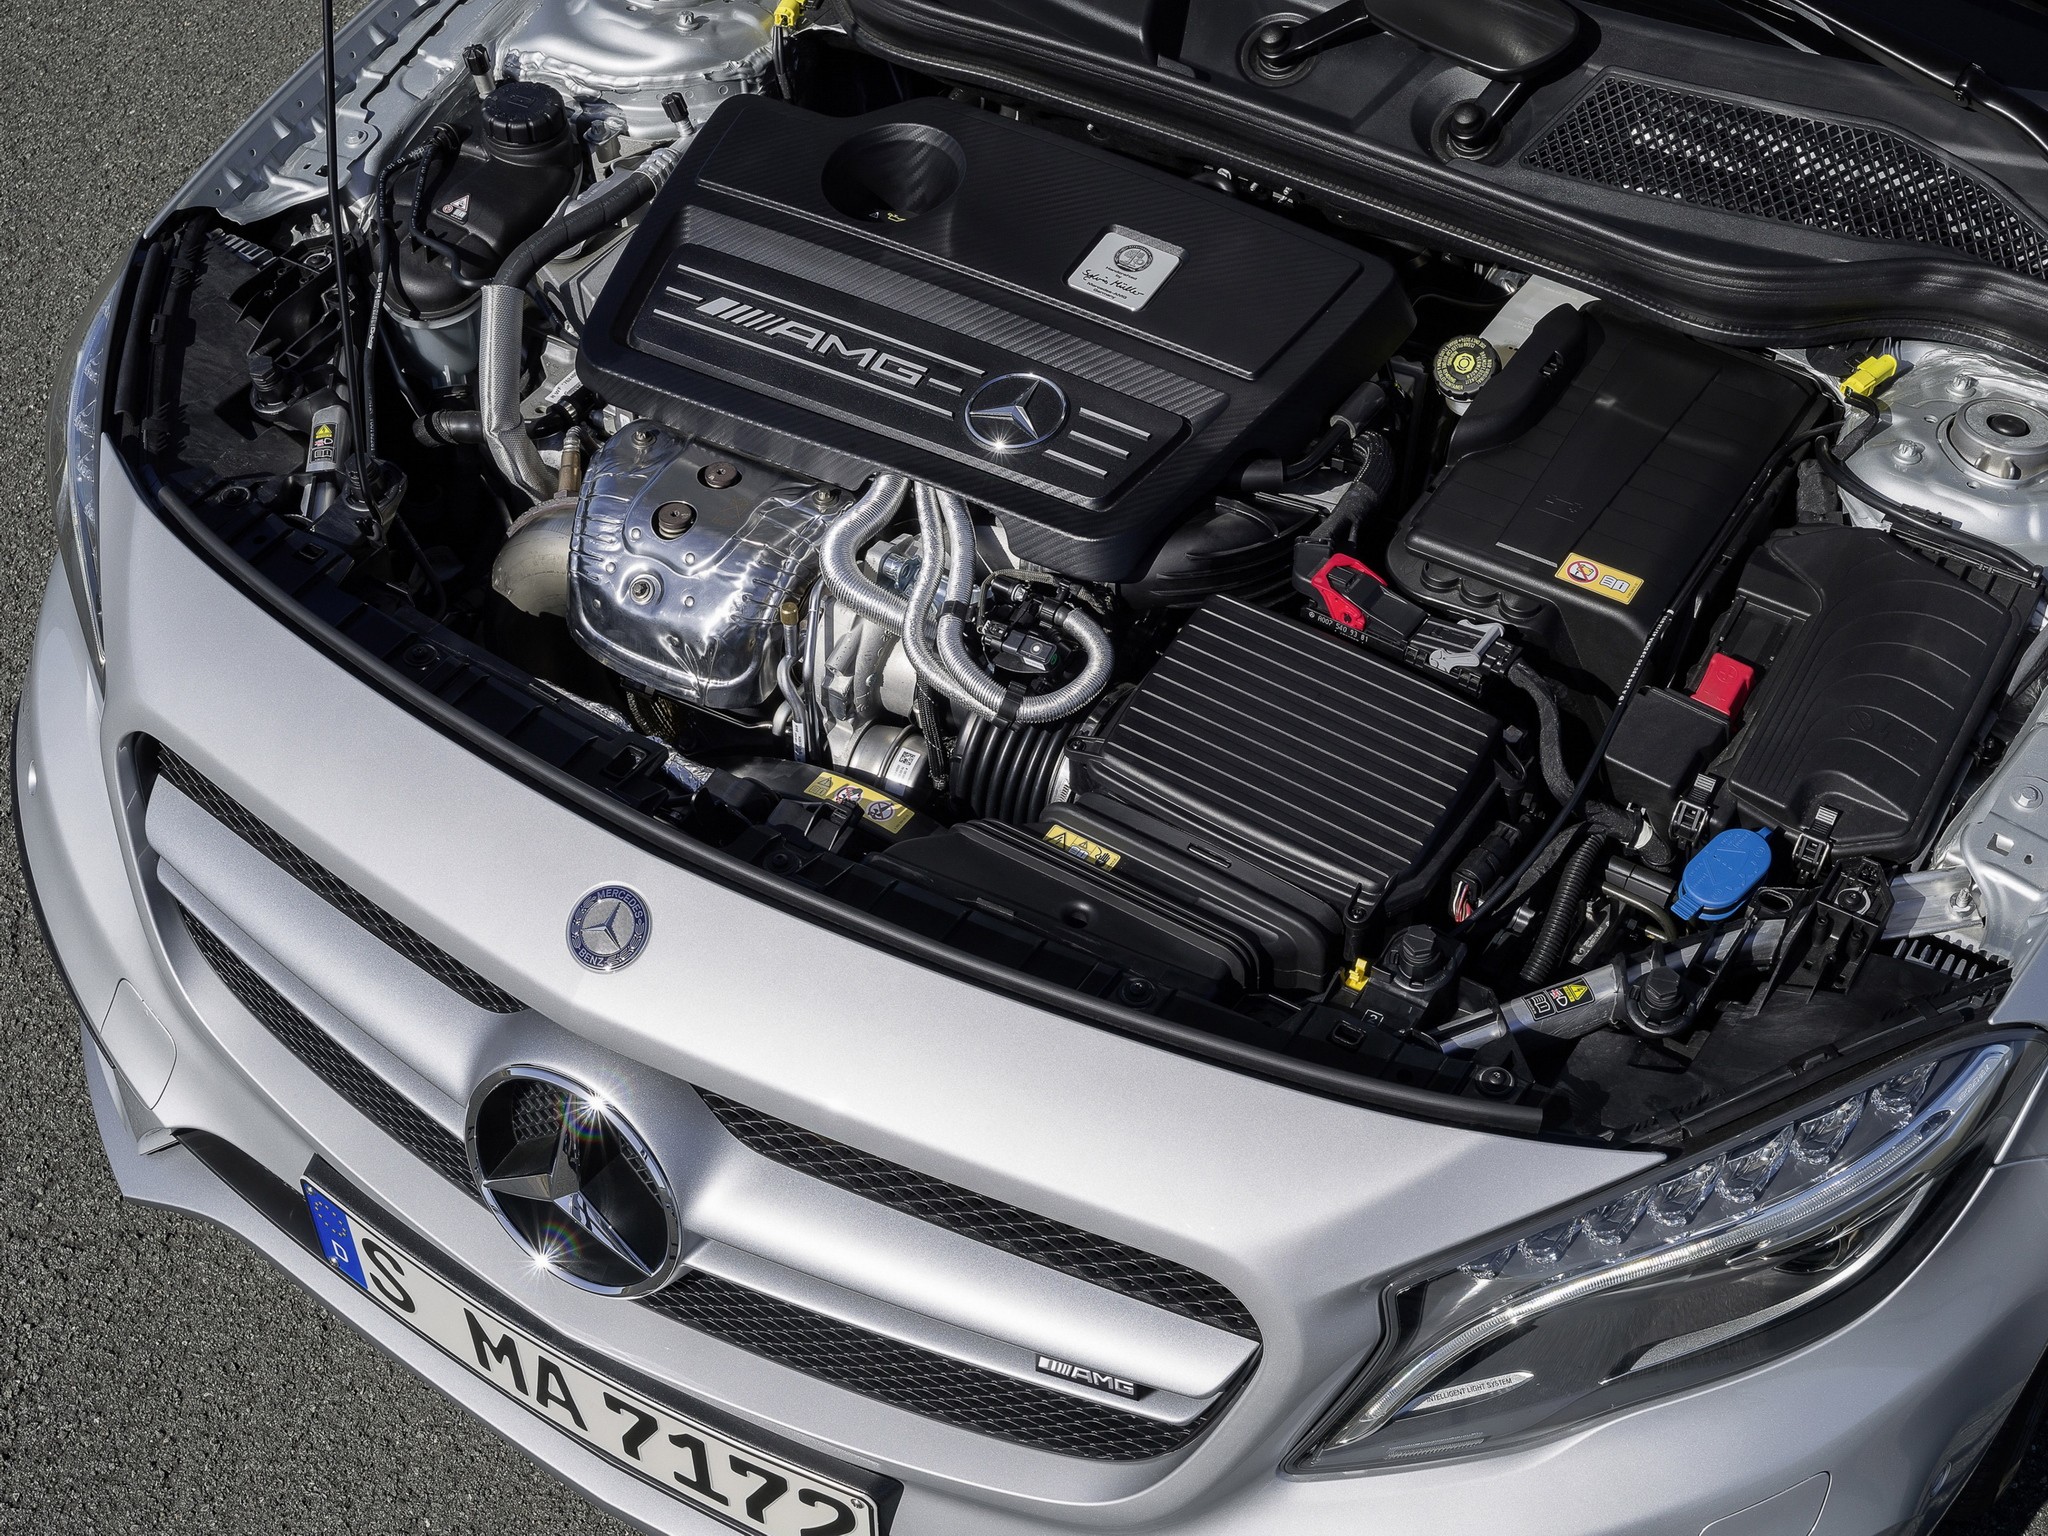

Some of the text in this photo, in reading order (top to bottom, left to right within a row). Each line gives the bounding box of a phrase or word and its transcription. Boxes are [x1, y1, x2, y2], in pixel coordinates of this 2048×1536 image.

[597, 888, 643, 918] MERCEDES
[578, 949, 604, 966] BENZ
[332, 1240, 348, 1263] D
[362, 1237, 416, 1313] S
[464, 1307, 589, 1432] MA
[1071, 1366, 1134, 1395] AMG
[1426, 1378, 1512, 1403] INTELLIGENT LIGHT SYSTEM
